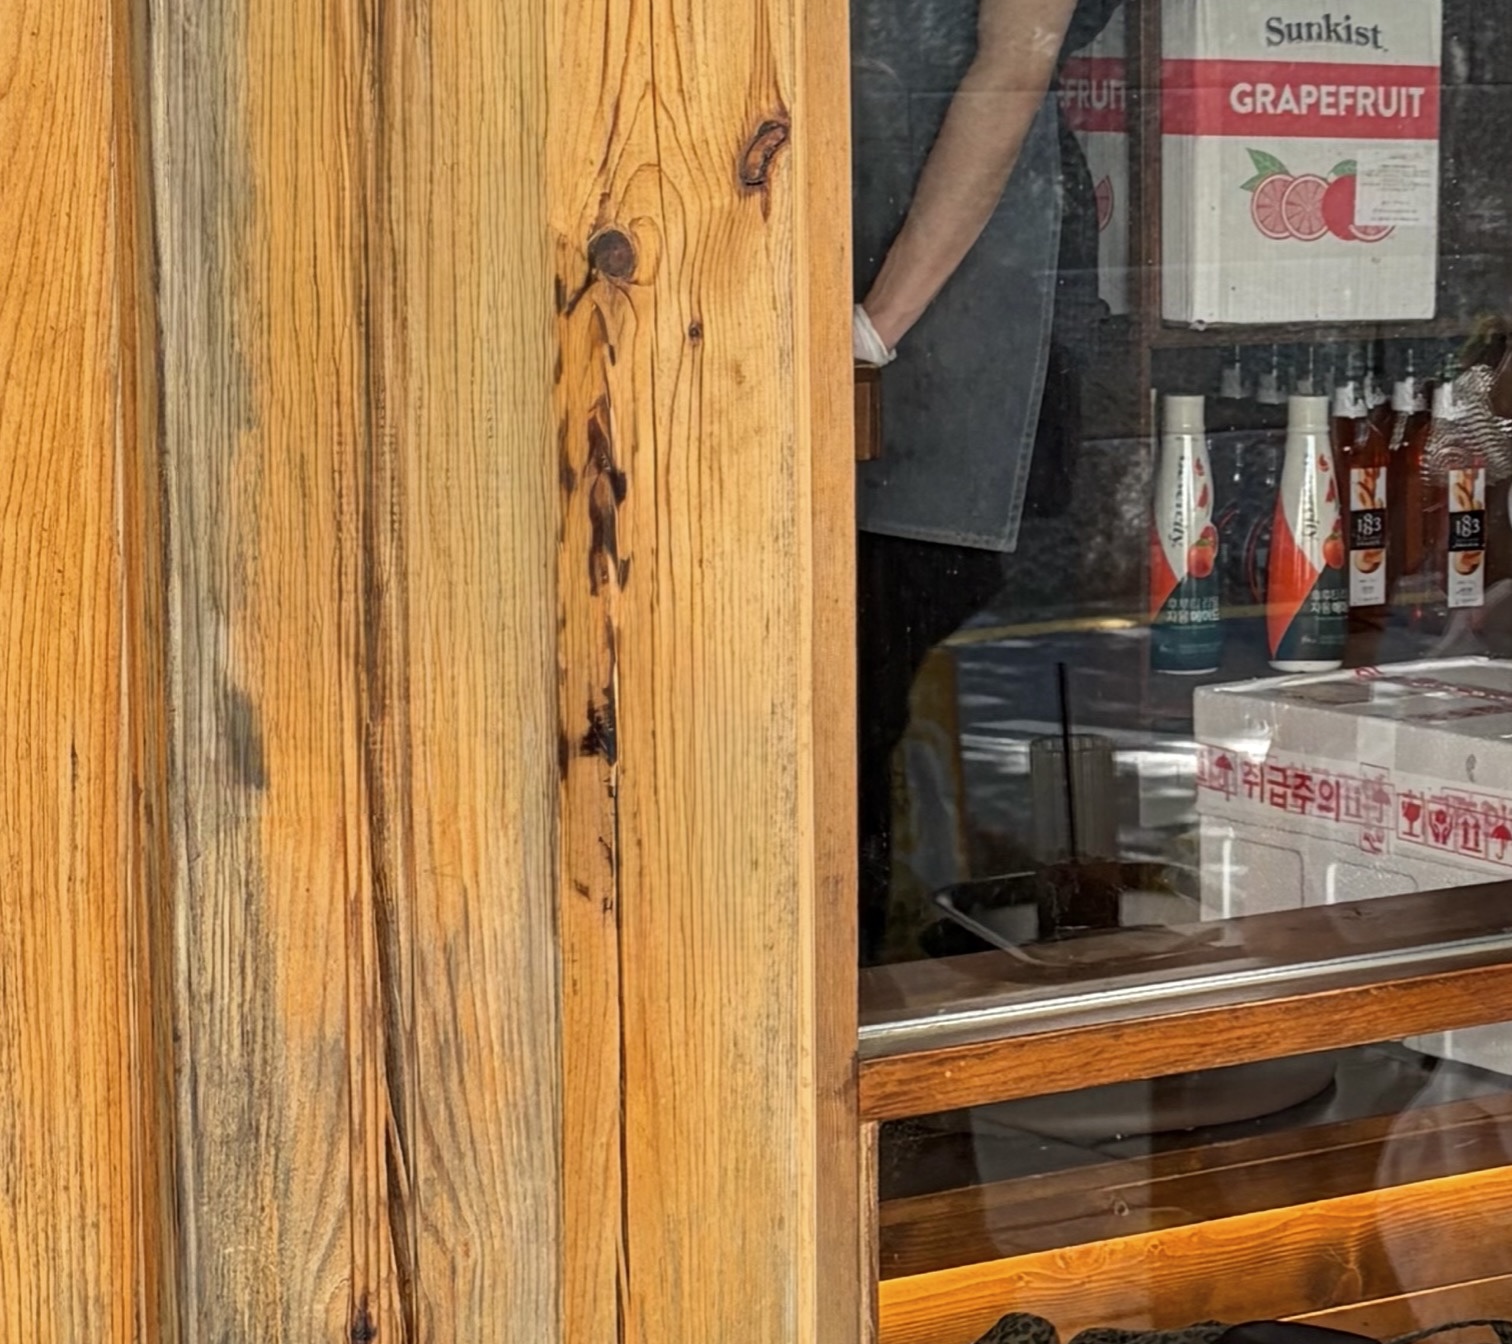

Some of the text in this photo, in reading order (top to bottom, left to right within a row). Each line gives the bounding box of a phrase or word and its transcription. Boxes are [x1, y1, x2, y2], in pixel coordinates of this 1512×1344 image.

[1265, 13, 1384, 50] Sunkist
[1229, 82, 1425, 118] GRAPEFRUIT
[1242, 760, 1341, 823] 취급주의
